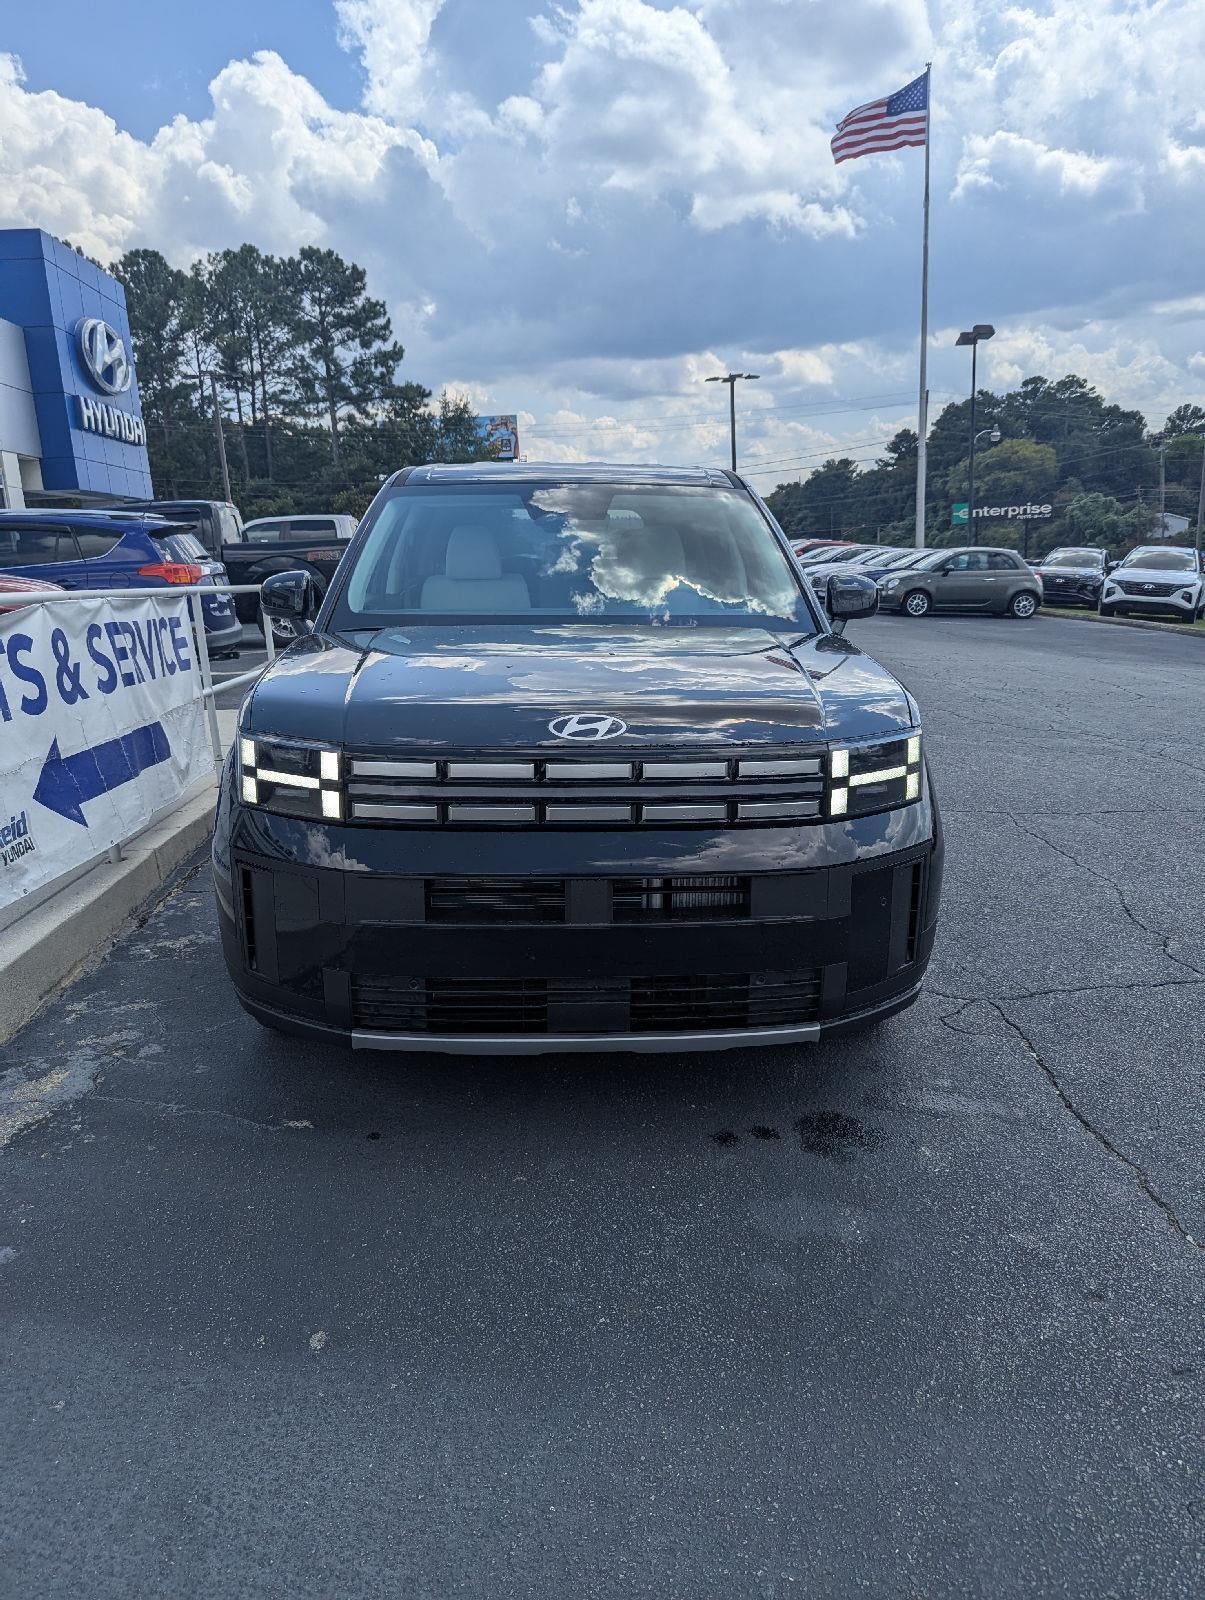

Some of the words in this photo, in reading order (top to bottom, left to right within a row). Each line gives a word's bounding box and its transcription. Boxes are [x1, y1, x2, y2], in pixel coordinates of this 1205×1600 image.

[79, 395, 147, 446] HYUNDAI
[51, 627, 90, 706] &
[86, 616, 192, 695] SERVICE
[0, 811, 28, 849] eid
